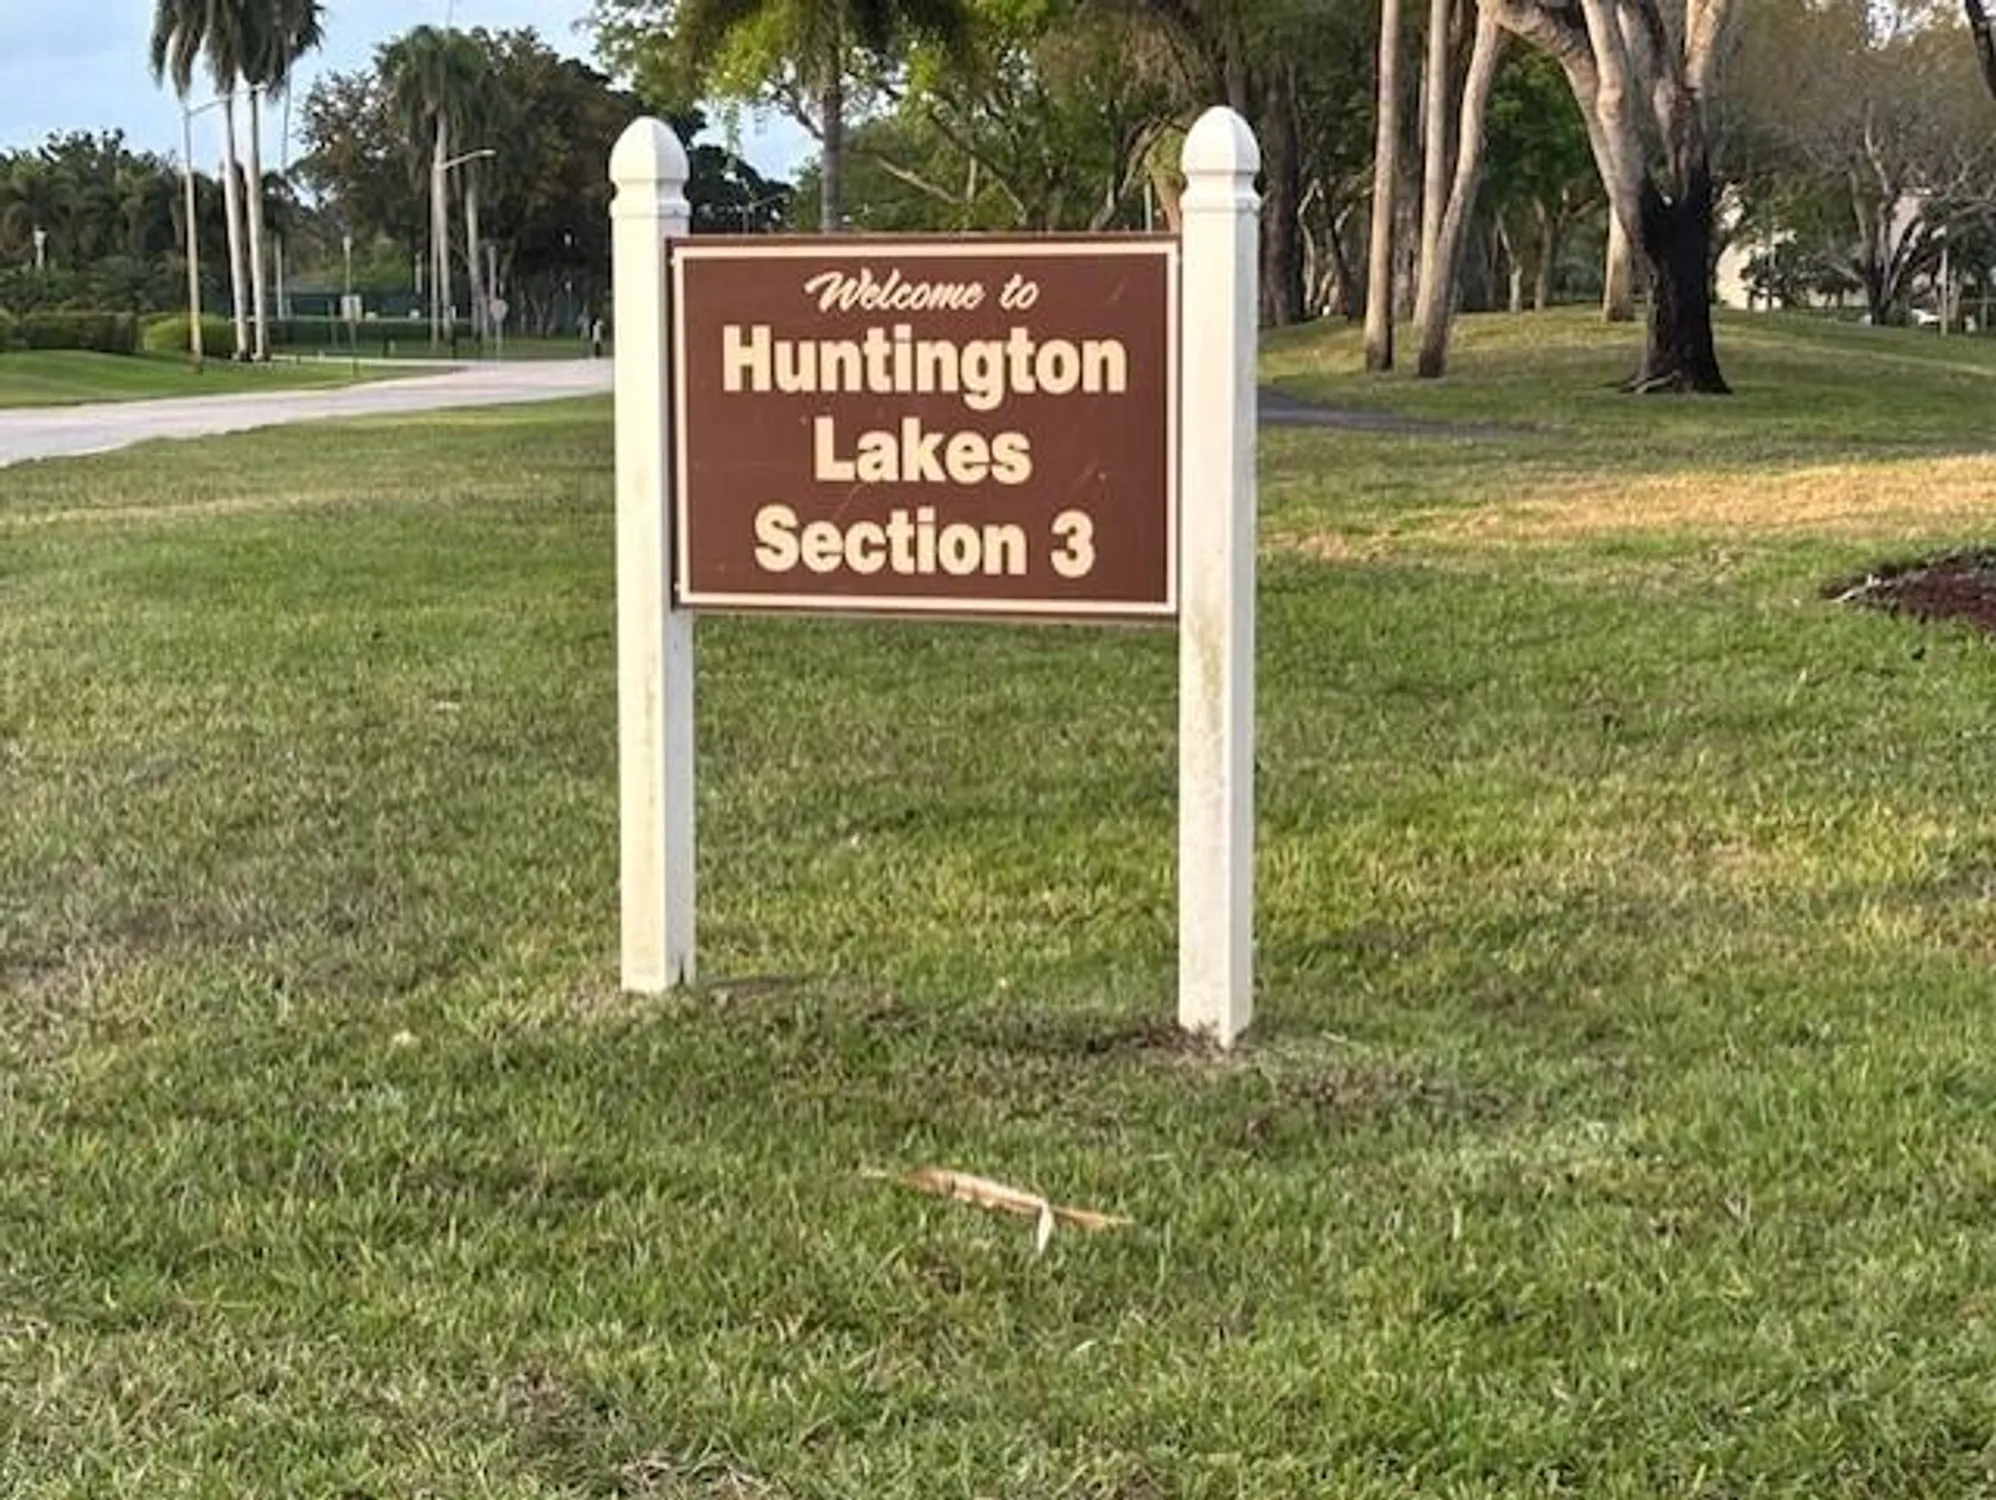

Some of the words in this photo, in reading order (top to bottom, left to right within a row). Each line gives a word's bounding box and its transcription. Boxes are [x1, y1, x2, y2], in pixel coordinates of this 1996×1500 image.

[804, 268, 985, 312] Welcome
[999, 273, 1040, 310] to
[722, 324, 1127, 411] Huntington
[814, 416, 1032, 484] Lakes
[754, 504, 1027, 575] Section
[1050, 510, 1096, 578] 3
